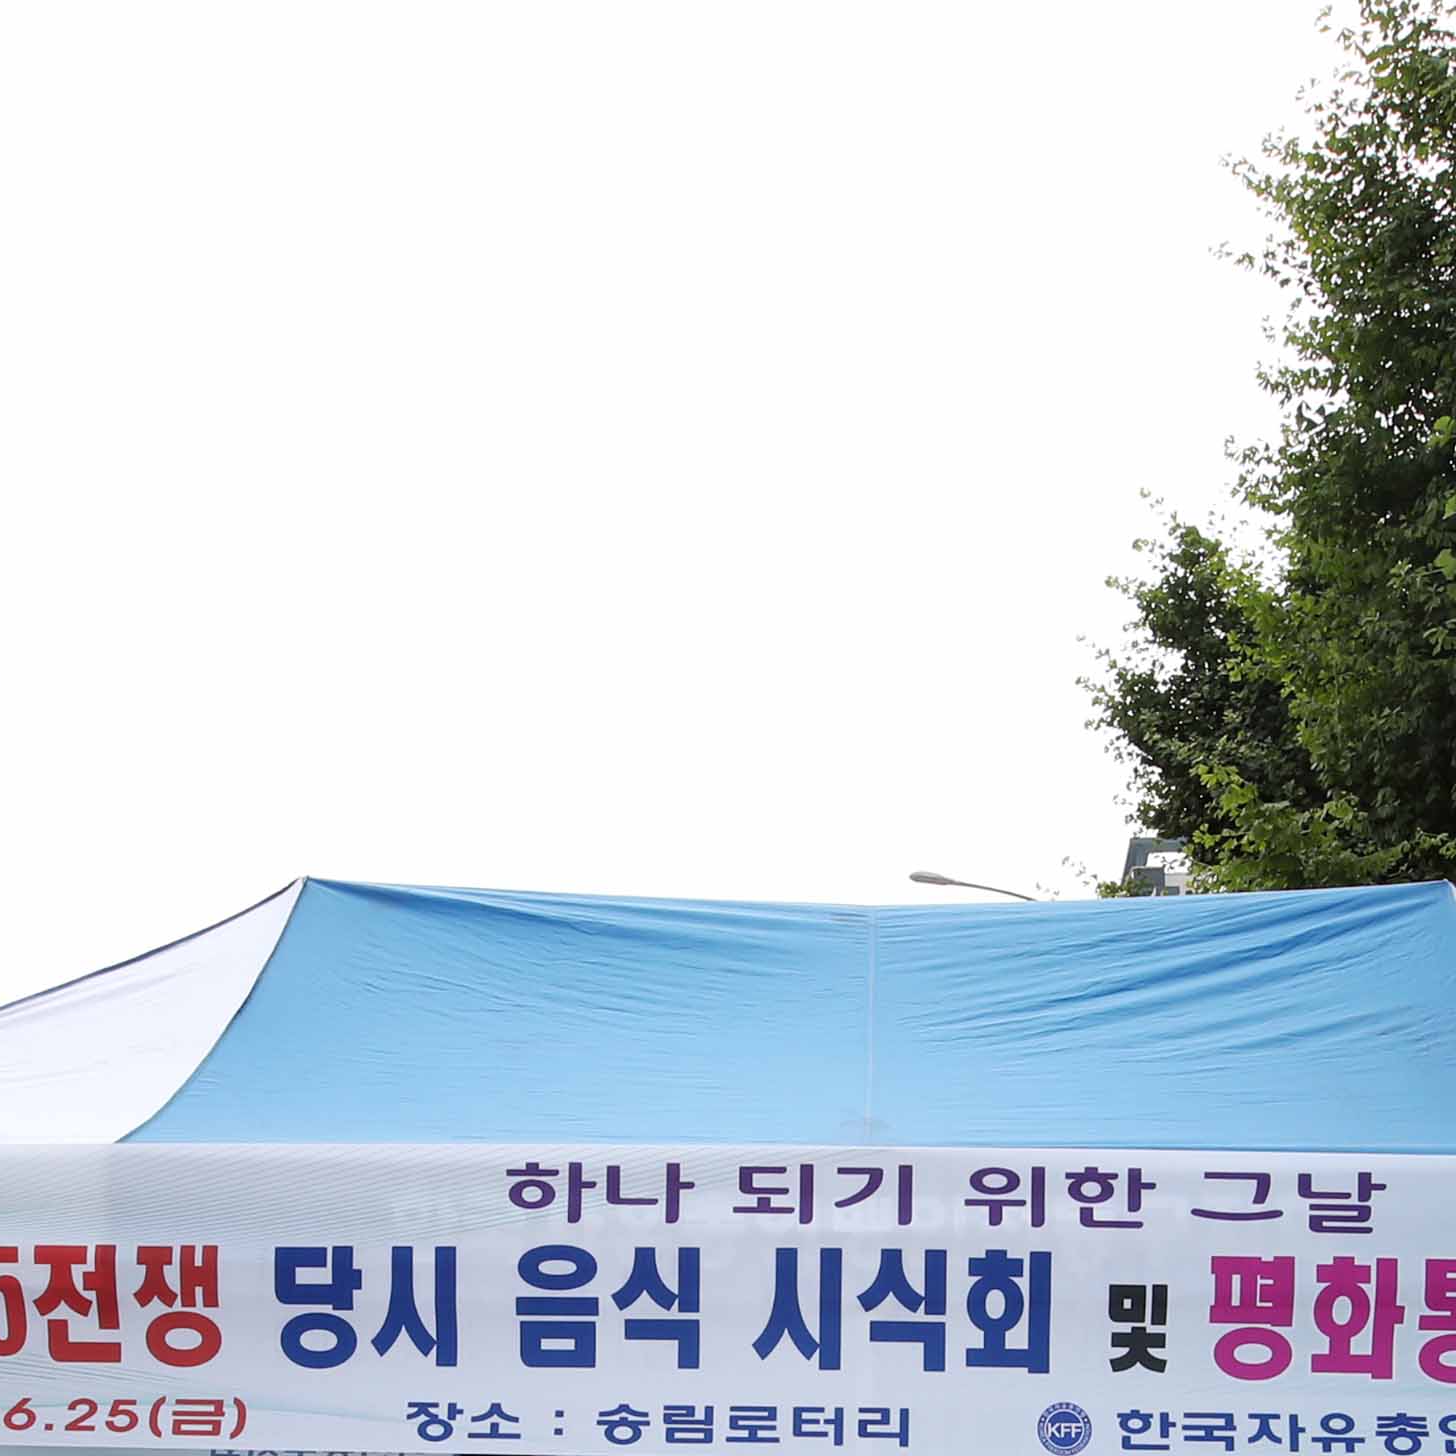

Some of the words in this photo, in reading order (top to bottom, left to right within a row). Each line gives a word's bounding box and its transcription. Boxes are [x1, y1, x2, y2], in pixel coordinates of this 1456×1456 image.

[506, 1161, 695, 1224] 하나
[732, 1163, 914, 1226] 되기
[964, 1165, 1157, 1229] 위한
[1190, 1171, 1387, 1235] 그날
[272, 1245, 459, 1370] 당시
[515, 1244, 702, 1370] 음식
[751, 1247, 1053, 1375] 시식회
[1107, 1284, 1169, 1374] 및
[3, 1397, 247, 1439] 6.25(금)
[406, 1401, 522, 1443] 장소
[596, 1402, 912, 1448] 송림로터리
